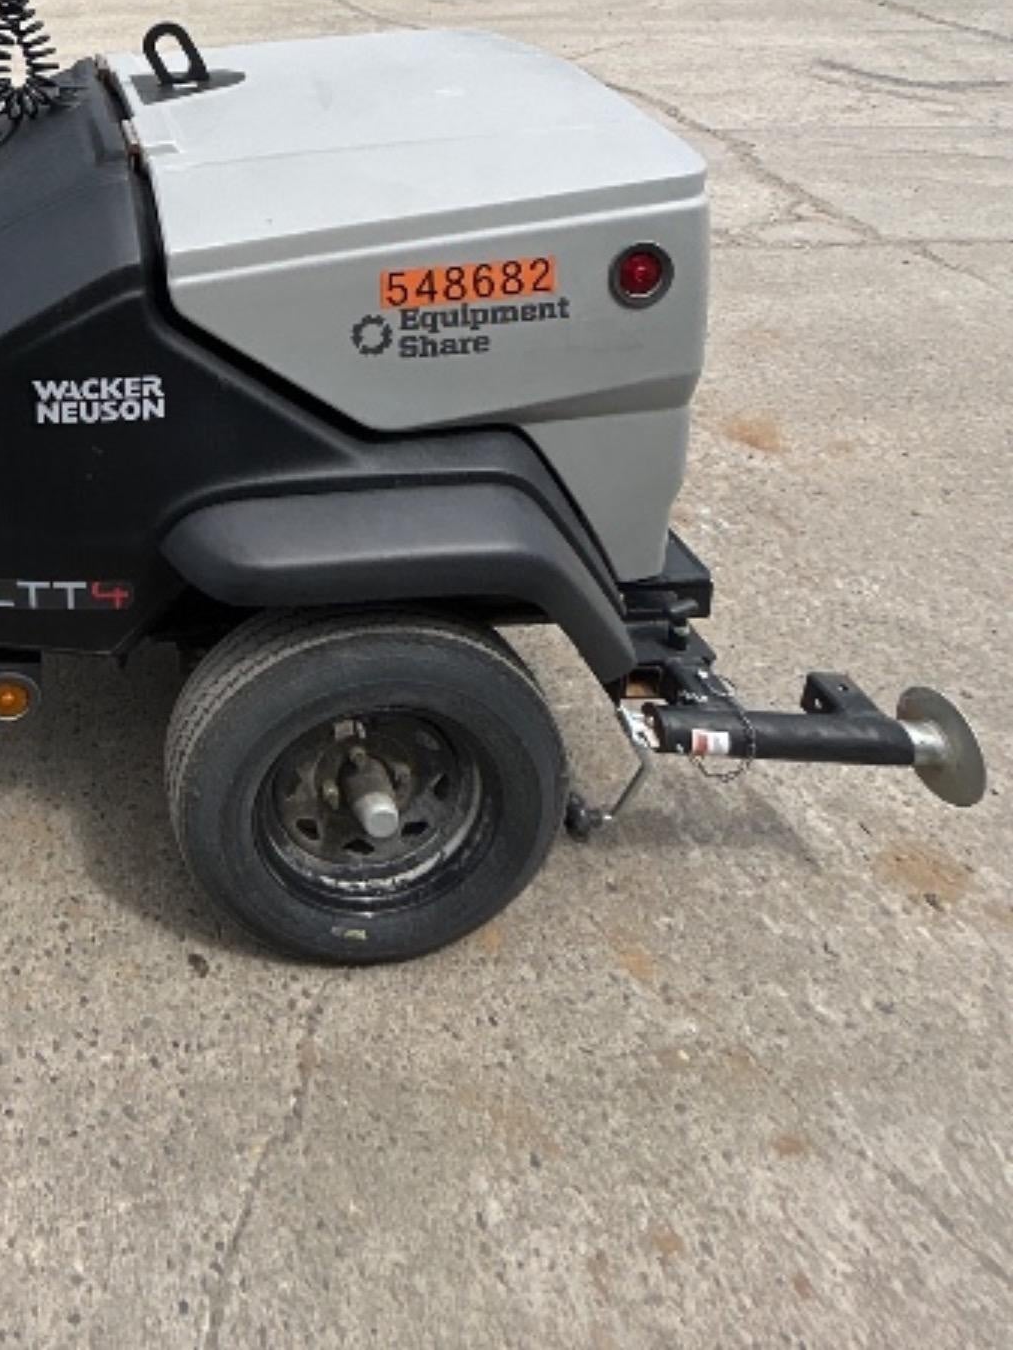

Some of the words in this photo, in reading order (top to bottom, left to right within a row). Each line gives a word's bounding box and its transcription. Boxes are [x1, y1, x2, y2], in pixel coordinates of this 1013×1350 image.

[386, 257, 552, 306] 548682
[399, 297, 571, 333] Equipment
[398, 335, 491, 359] Share
[32, 374, 165, 401] WACKER
[37, 398, 165, 424] NEUSON
